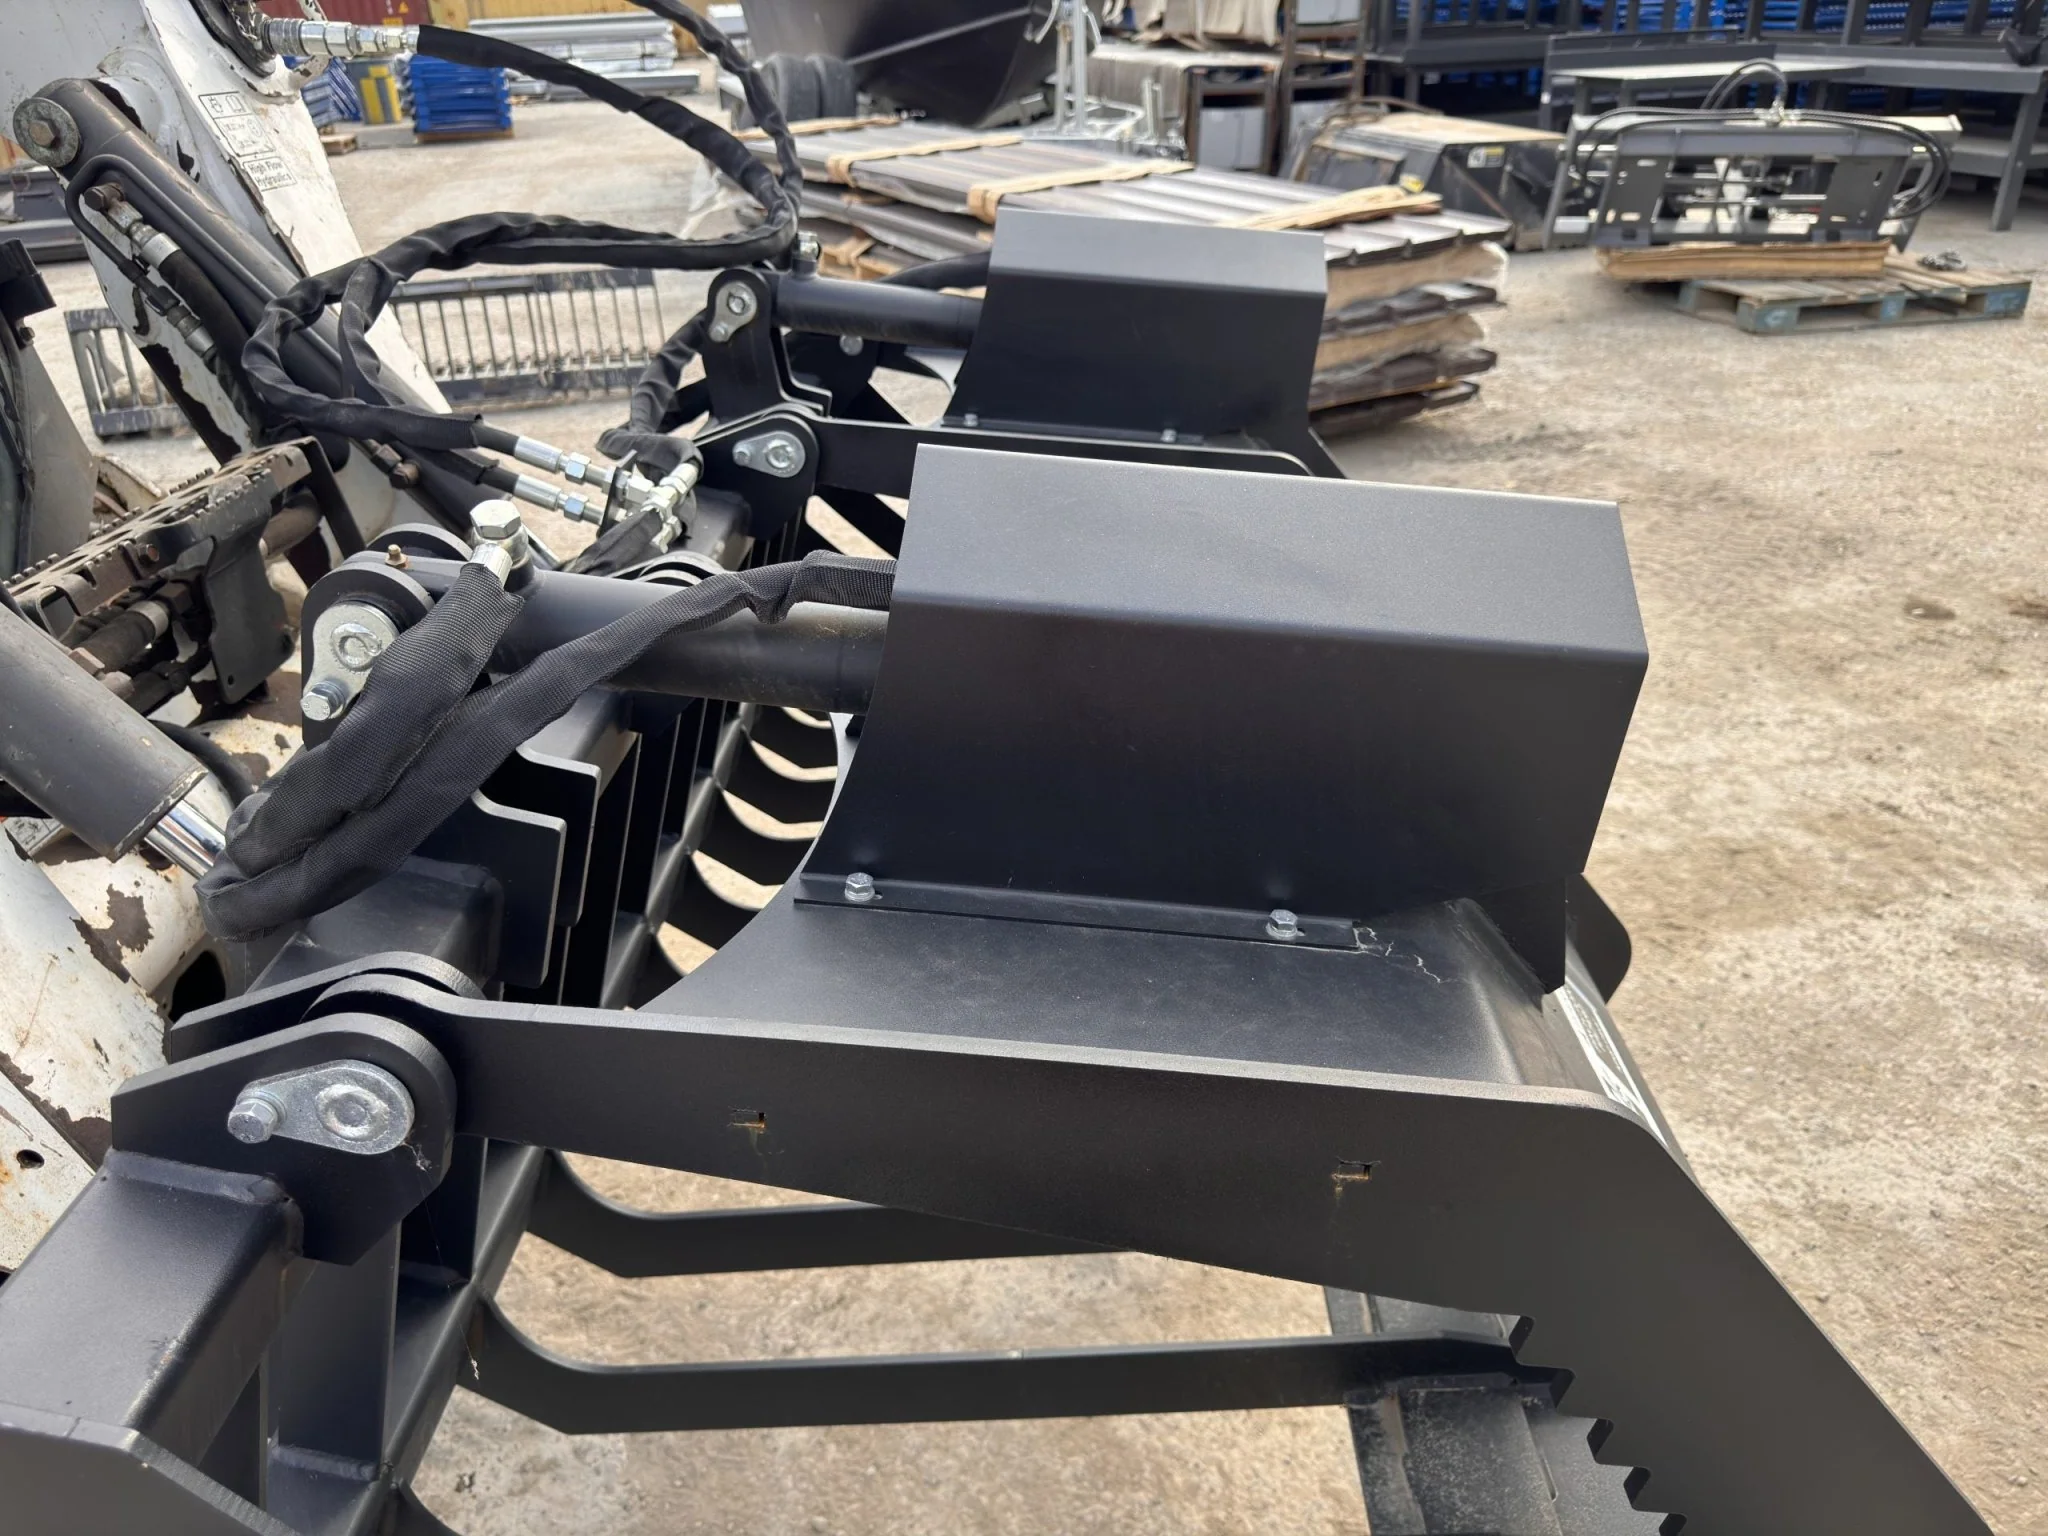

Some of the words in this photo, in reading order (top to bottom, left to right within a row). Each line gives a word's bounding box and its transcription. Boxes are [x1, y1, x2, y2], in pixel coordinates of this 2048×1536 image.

[248, 162, 266, 175] High
[265, 160, 283, 171] Flow
[255, 172, 292, 187] Hydraulics
